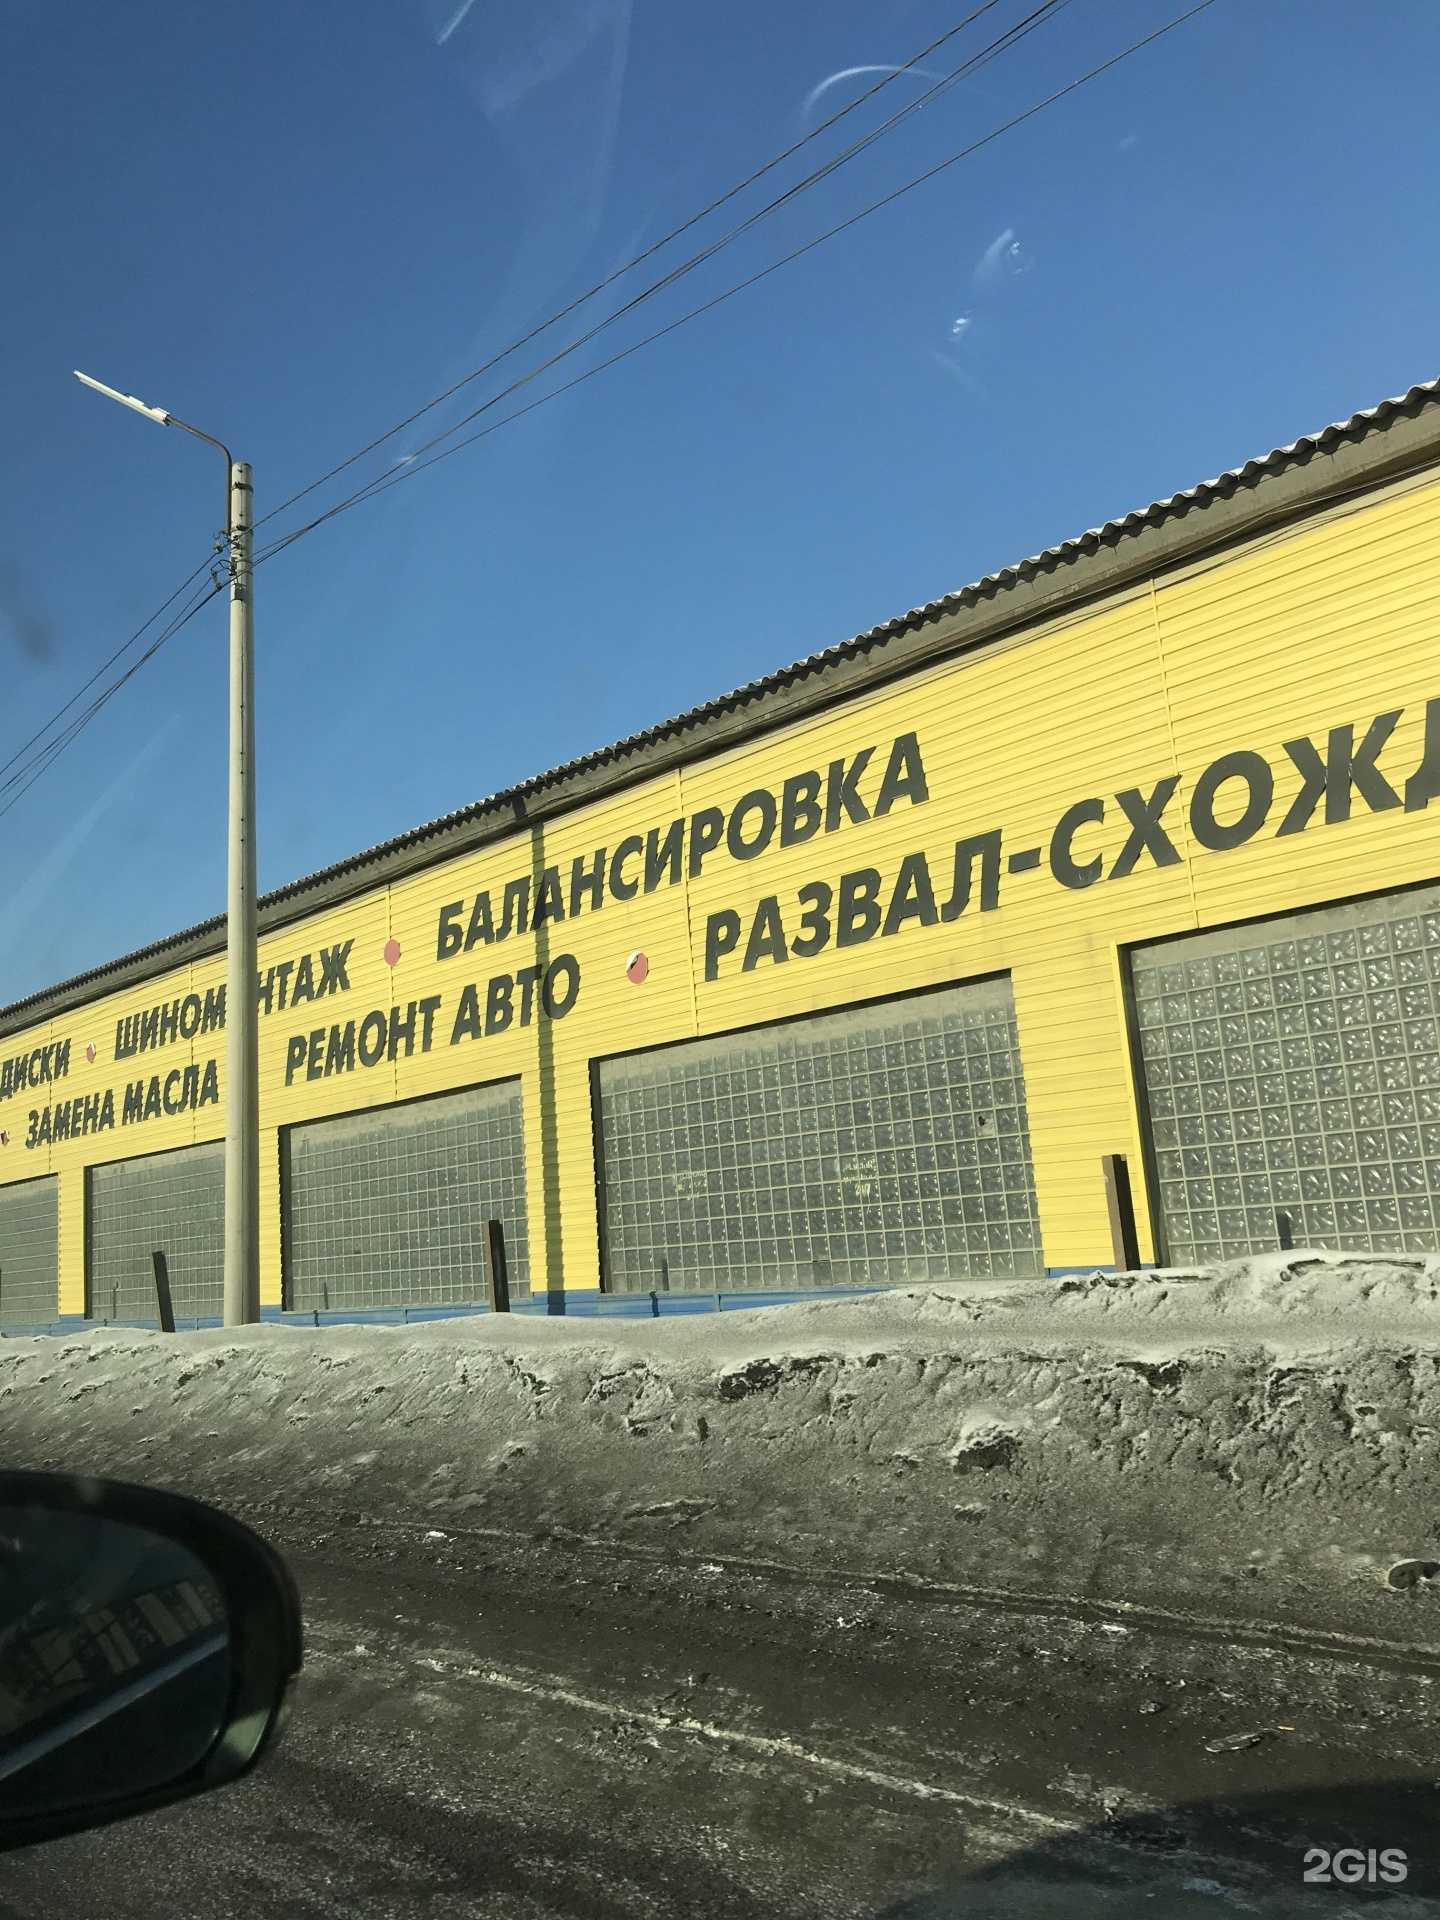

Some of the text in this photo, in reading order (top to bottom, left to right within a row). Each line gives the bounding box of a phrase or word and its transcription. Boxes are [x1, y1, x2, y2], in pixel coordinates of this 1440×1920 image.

[436, 731, 930, 961] БАЛАНСИРОВКА
[114, 938, 354, 1061] ШИНОМНТАЖ
[285, 953, 581, 1087] РЕМОНТ АВТО
[0, 1038, 71, 1102] ДИСКИ
[26, 1060, 219, 1149] ЗАМЕНА МАСЛА
